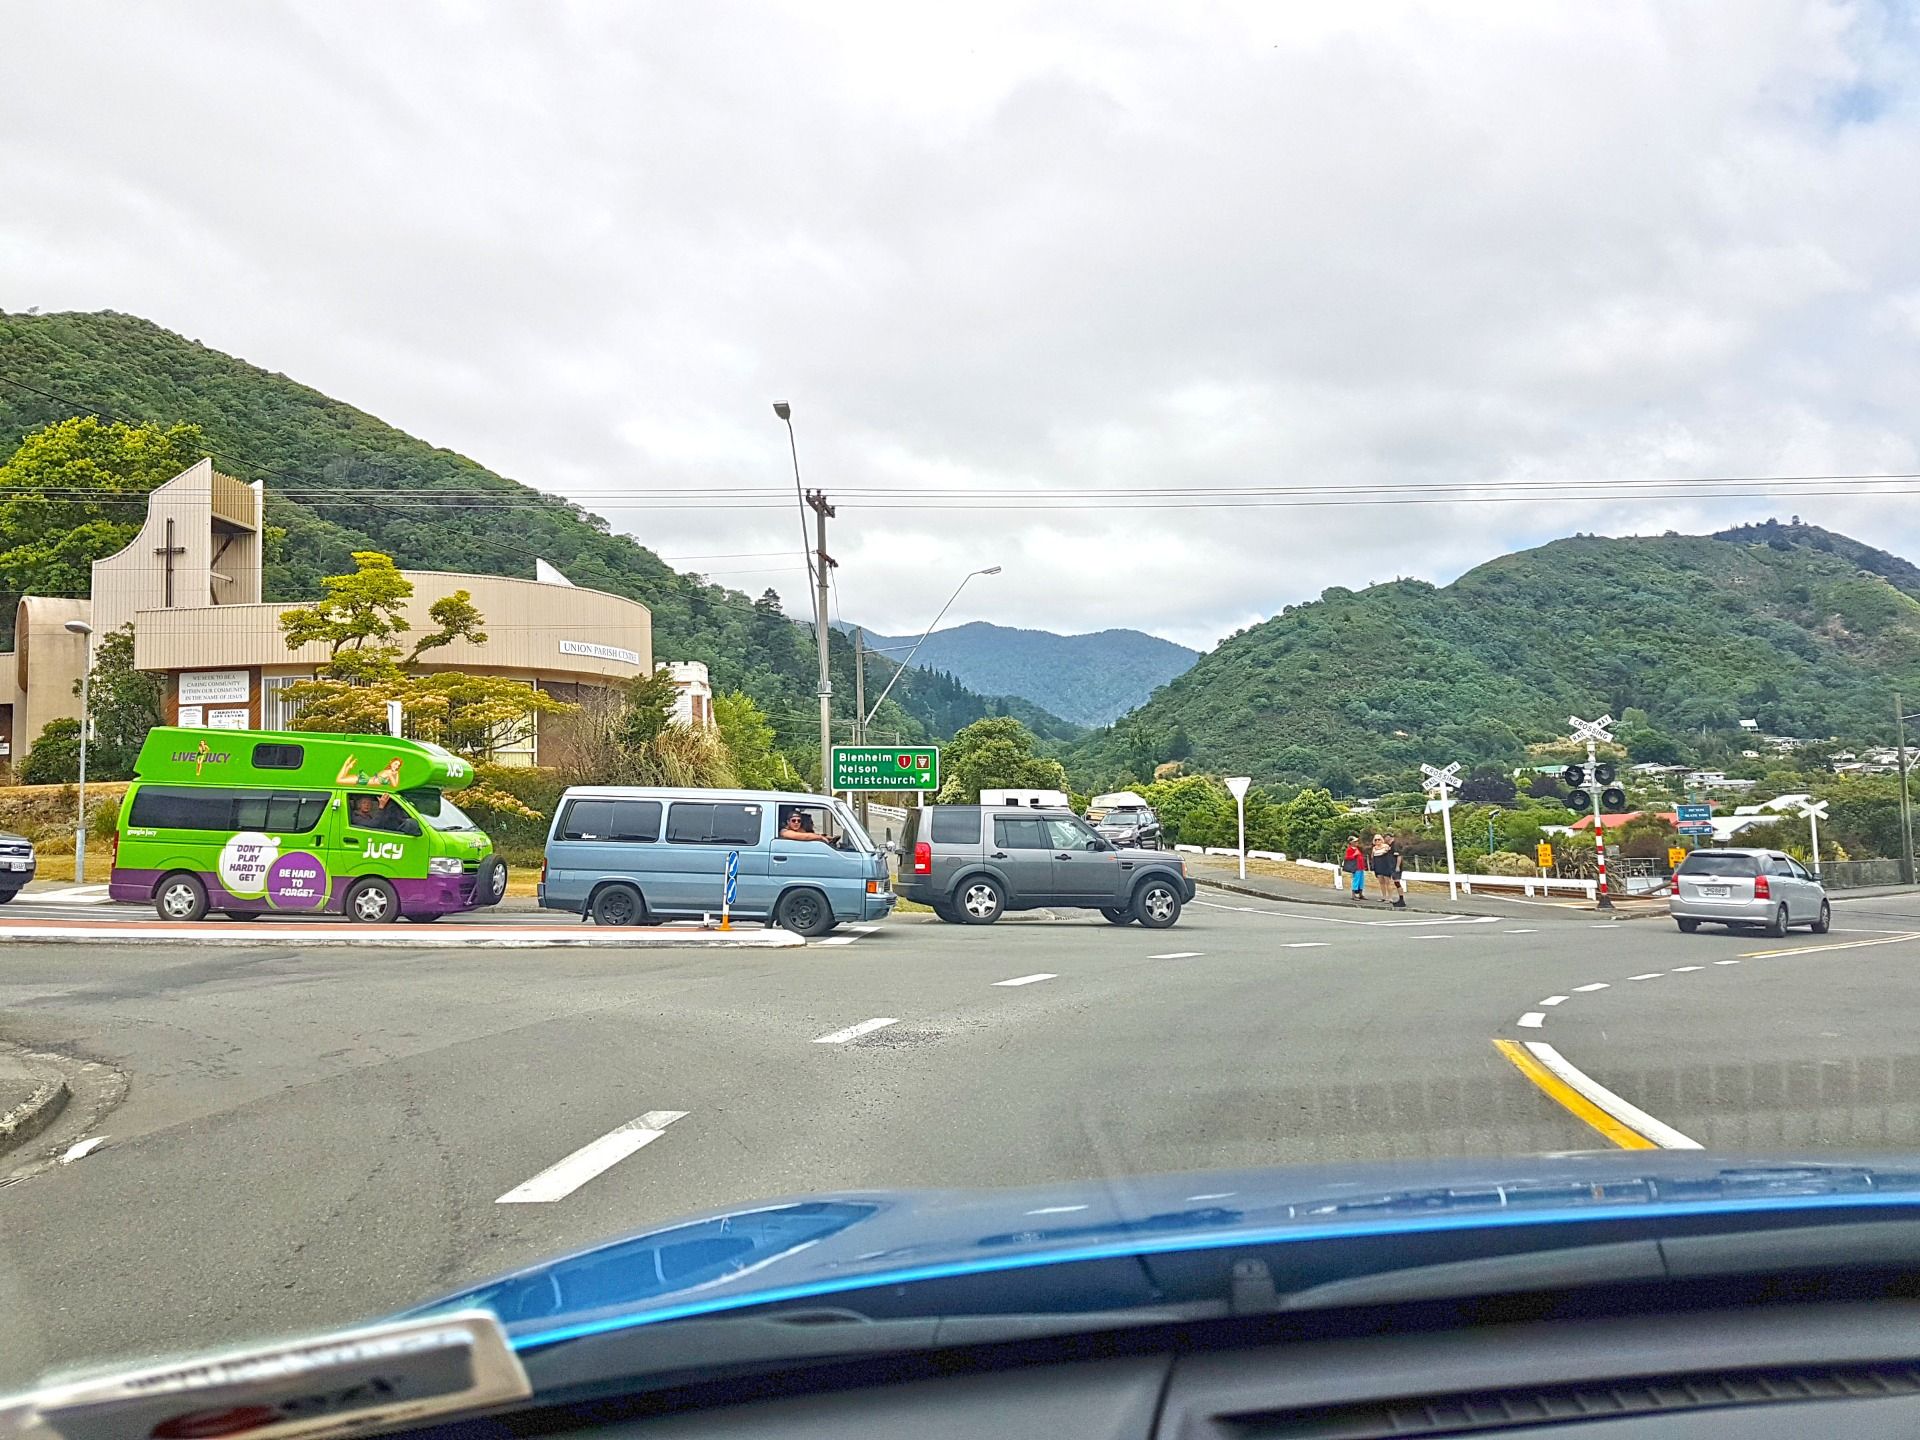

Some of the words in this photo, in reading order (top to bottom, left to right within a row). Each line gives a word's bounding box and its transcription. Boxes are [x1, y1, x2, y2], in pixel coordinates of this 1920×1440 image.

[564, 642, 592, 654] UNION
[594, 646, 618, 657] PARISH
[1572, 732, 1587, 741] RAIL
[1597, 717, 1608, 726] WAY
[1574, 720, 1608, 739] CROSSING
[172, 752, 196, 762] LIVE
[203, 753, 230, 763] JUCY
[839, 753, 892, 762] Blenheim
[903, 757, 906, 766] 1
[839, 765, 878, 773] Nelson
[839, 776, 915, 784] Christchurch
[1425, 766, 1458, 785] CROSSING
[1425, 778, 1438, 788] RAIL
[1447, 765, 1457, 773] WAY
[362, 838, 403, 859] jucy
[279, 869, 291, 877] BE
[292, 870, 316, 878] HARD
[292, 879, 303, 887] TO
[280, 888, 314, 897] FORGET
